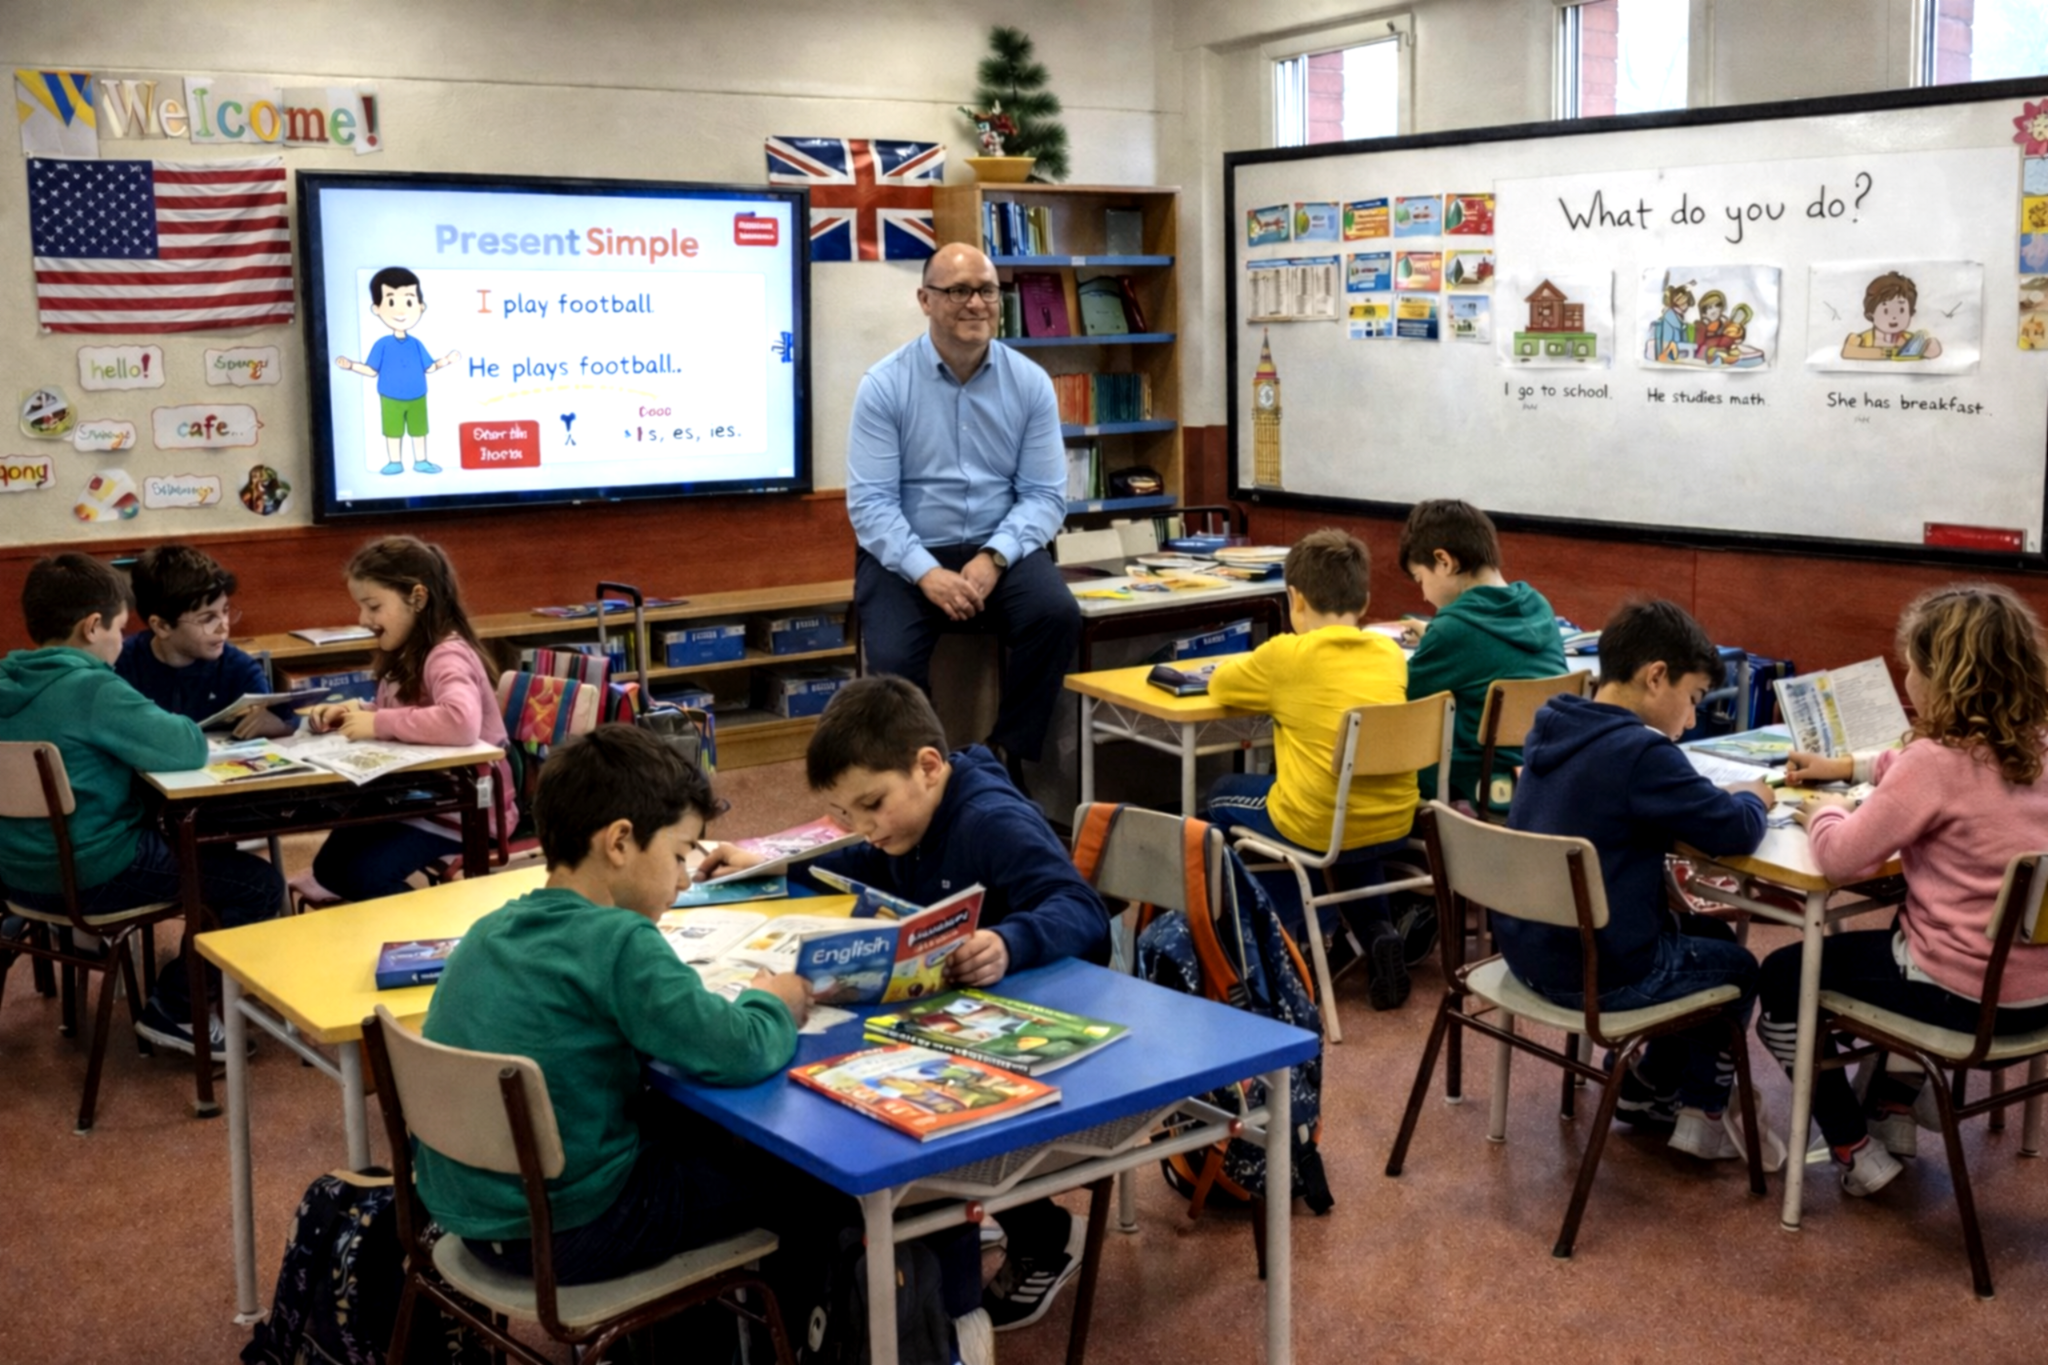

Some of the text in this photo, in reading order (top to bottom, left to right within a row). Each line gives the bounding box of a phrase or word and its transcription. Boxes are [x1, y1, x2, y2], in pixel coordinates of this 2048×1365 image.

[101, 79, 378, 147] Welcome!
[1558, 171, 1872, 244] What do you do?
[435, 224, 699, 264] Present Simple
[476, 289, 492, 313] I
[504, 292, 549, 319] play
[90, 352, 151, 379] hello!
[469, 357, 500, 378] He
[513, 356, 569, 382] plays
[1504, 381, 1509, 397] I
[1518, 386, 1534, 401] go
[1541, 384, 1556, 397] to
[1647, 387, 1665, 403] He
[1672, 389, 1722, 405] studies
[1827, 391, 1857, 409] She
[1864, 392, 1890, 409] has
[673, 427, 701, 442] es,
